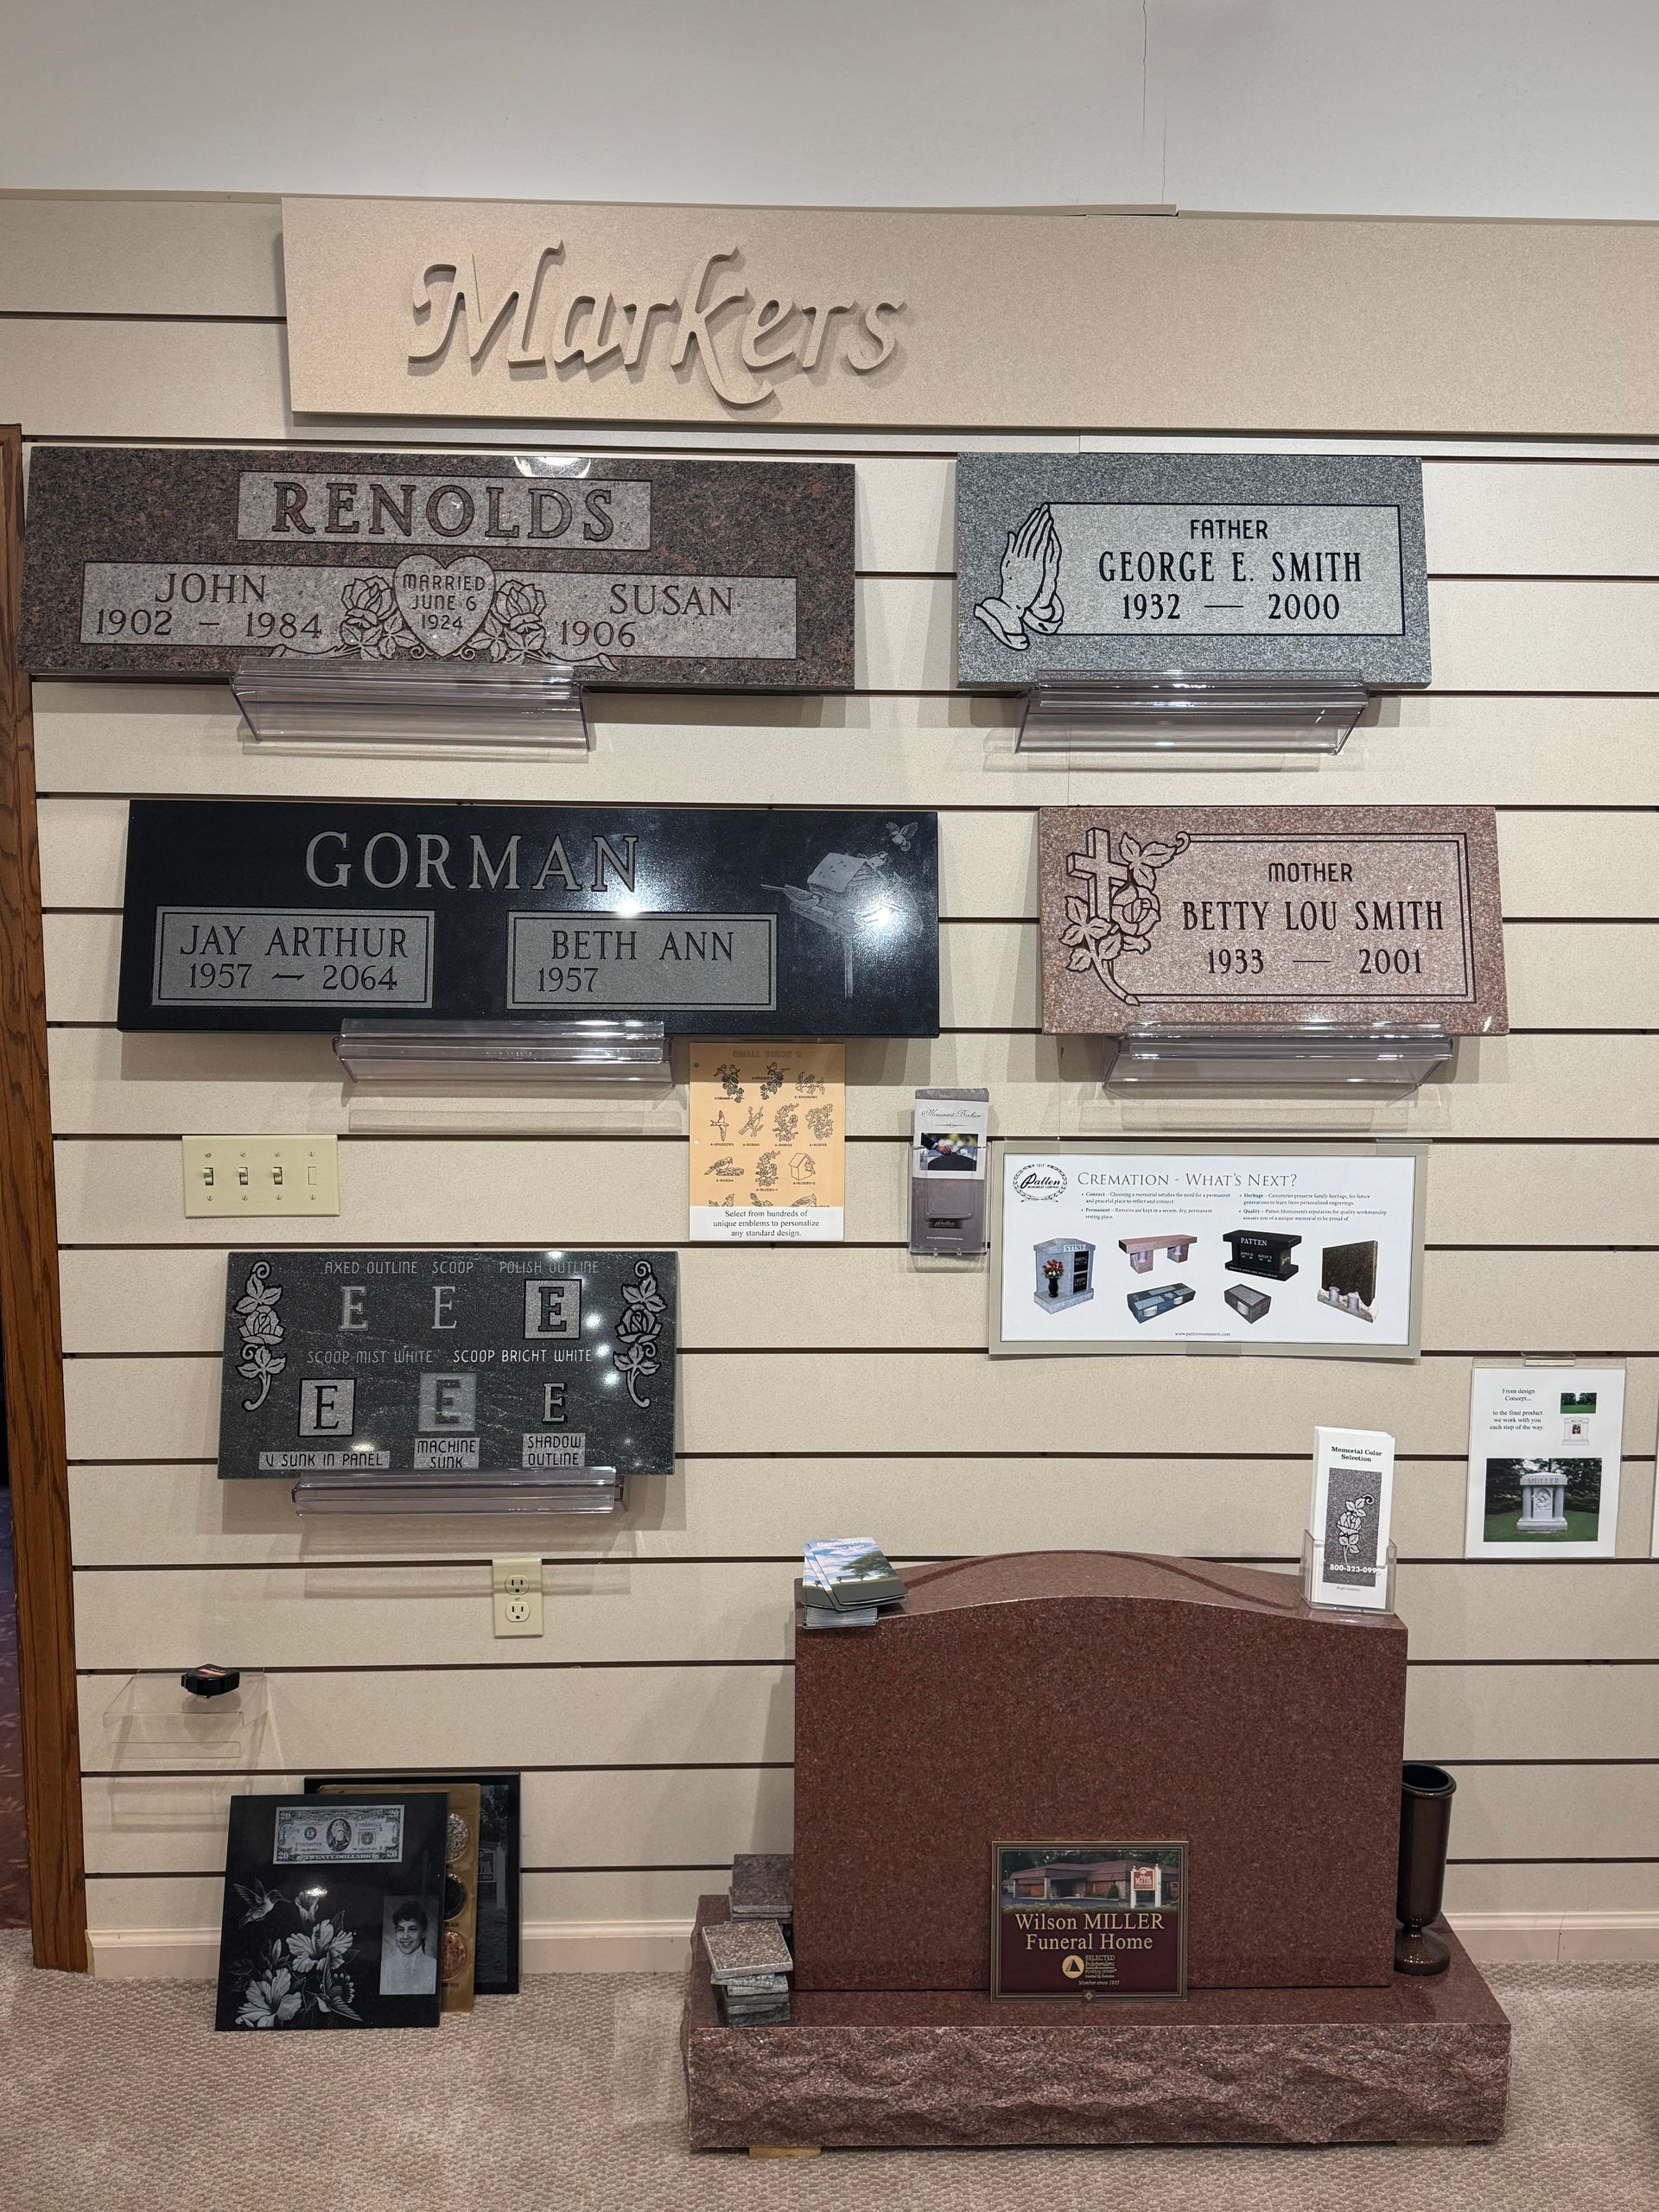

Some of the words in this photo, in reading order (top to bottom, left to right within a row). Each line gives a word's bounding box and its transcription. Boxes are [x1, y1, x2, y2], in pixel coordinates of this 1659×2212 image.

[408, 239, 906, 405] Markers
[271, 481, 614, 542] RENOLDS
[1190, 519, 1268, 539] FATHER
[1098, 551, 1215, 582] GEORGE
[1231, 551, 1254, 582] E.
[1272, 551, 1362, 582] SMITH
[155, 573, 267, 605] JOHN
[403, 574, 486, 591] MARRIED
[411, 594, 457, 610] JUNE
[466, 596, 477, 611] 6
[609, 583, 733, 616] SUSAN
[1122, 594, 1181, 620] 1932
[1268, 594, 1339, 620] 2000
[96, 608, 172, 636] 1902
[246, 612, 323, 639] 1984
[421, 614, 463, 630] 1924
[560, 620, 637, 648] 1906
[305, 830, 639, 893] GORMAN
[1268, 862, 1353, 882] MOTHER
[1182, 901, 1269, 931] BETTY
[1285, 901, 1338, 931] LOU
[1355, 901, 1444, 931] SMITH
[180, 925, 246, 955] JAY
[264, 926, 409, 958] ARTHUR
[551, 930, 638, 961] BETH
[658, 931, 734, 962] ANN
[1208, 949, 1264, 975] 1933
[1358, 949, 1422, 975] 2001
[189, 963, 253, 988] 1957
[322, 964, 397, 990] 2064
[537, 967, 599, 992] 1957
[1077, 1172, 1169, 1186] CREMATION
[1185, 1173, 1242, 1186] WHAT'S
[1248, 1173, 1298, 1187] NEXT?
[1240, 1237, 1268, 1247] PATTEN
[325, 1261, 359, 1274] AXED
[366, 1261, 418, 1274] OUTLINE
[432, 1261, 474, 1274] SCOOP
[499, 1261, 542, 1274] POLISH
[549, 1261, 599, 1274] OUTLINE
[338, 1285, 368, 1331] E
[431, 1286, 457, 1329] E
[537, 1287, 567, 1332] E
[307, 1351, 350, 1363] SCOOP
[356, 1351, 389, 1363] MIST
[393, 1350, 432, 1363] WHITE
[454, 1350, 495, 1363] SCOOP
[501, 1349, 547, 1362] BRIGHT
[554, 1349, 592, 1362] WHITE
[313, 1385, 340, 1430] E
[435, 1379, 461, 1424] E
[542, 1382, 568, 1425] E
[417, 1440, 476, 1452] MACHINE
[527, 1435, 581, 1448] SHADOW
[1332, 1446, 1363, 1454] Memorial
[266, 1454, 274, 1466] V
[282, 1453, 315, 1466] SUNK
[323, 1453, 335, 1466] IN
[342, 1452, 383, 1466] PANEL
[430, 1456, 463, 1469] SUNK
[528, 1452, 579, 1465] OUTLINE
[1341, 1453, 1371, 1462] Selection
[1014, 1912, 1077, 1930] Wilson
[1084, 1913, 1165, 1929] MILLER
[1026, 1933, 1093, 1950] Funeral
[1099, 1933, 1153, 1950] Home
